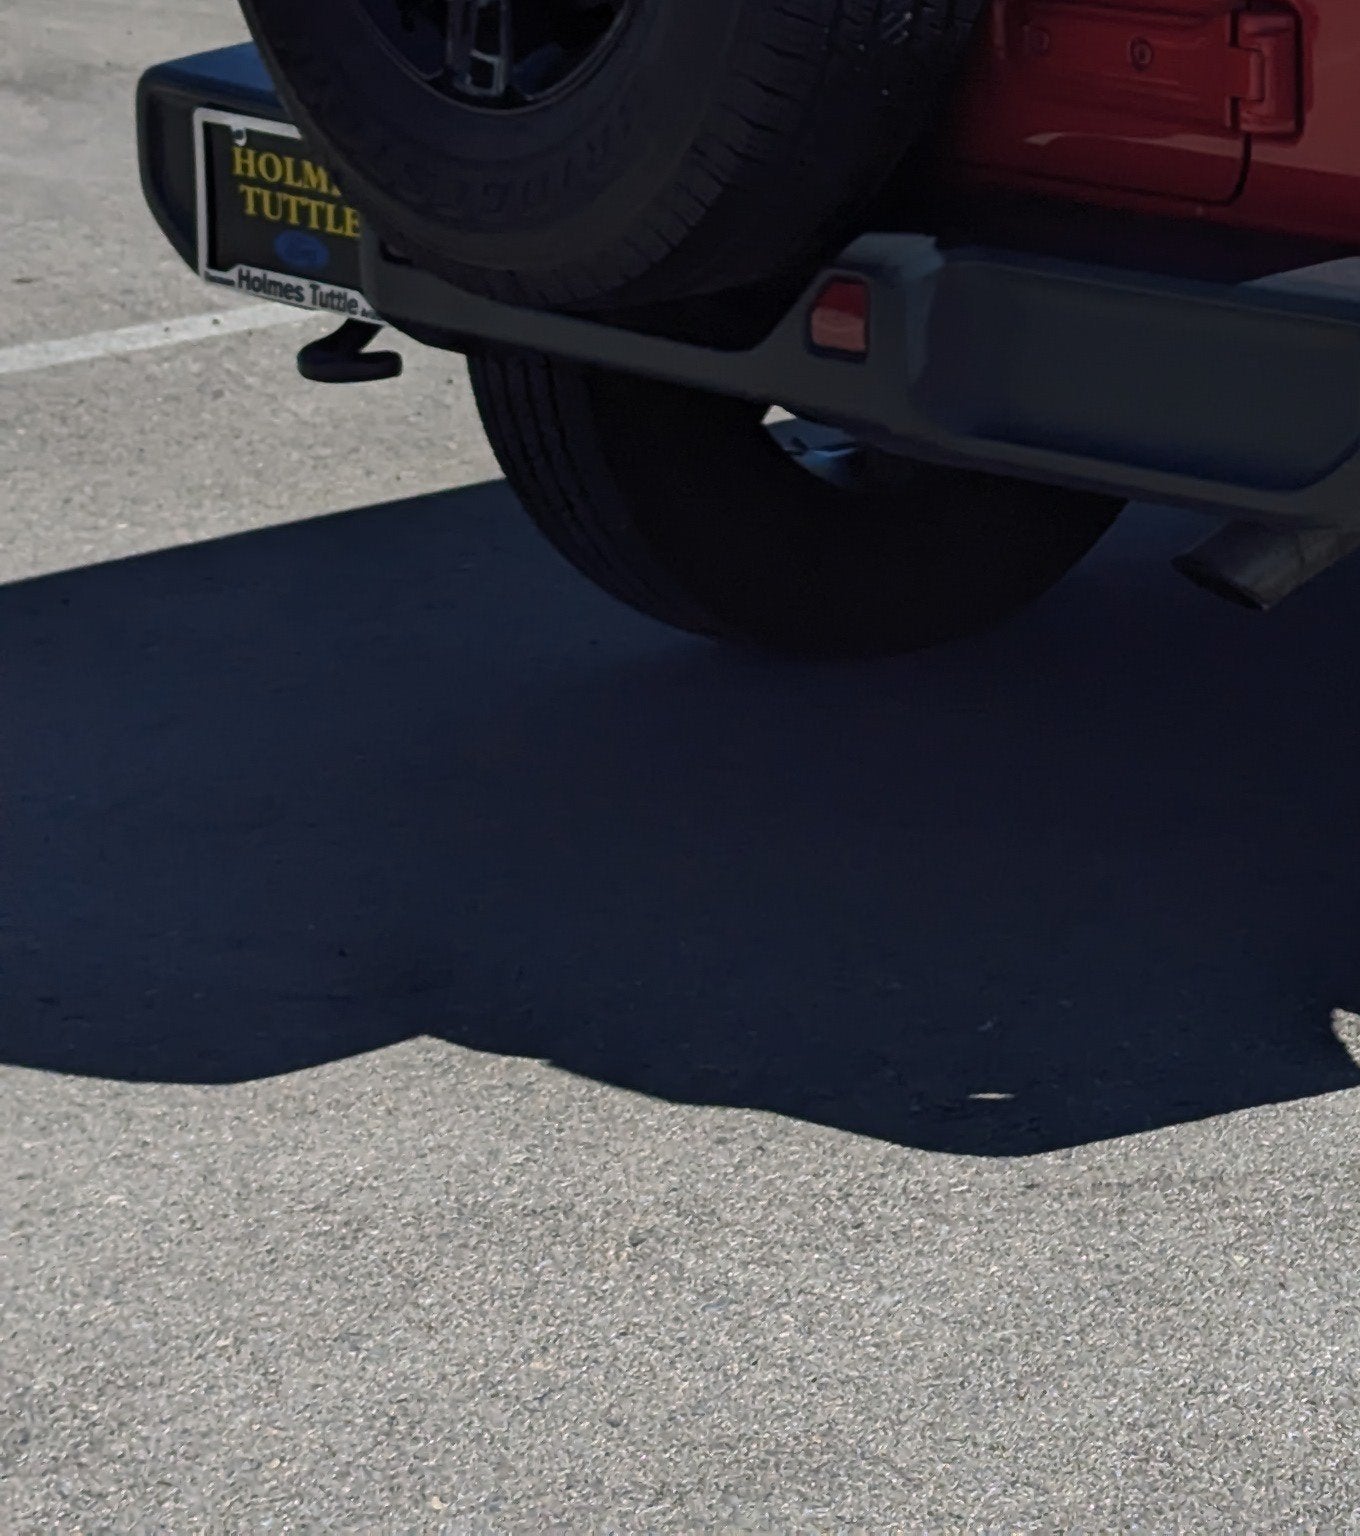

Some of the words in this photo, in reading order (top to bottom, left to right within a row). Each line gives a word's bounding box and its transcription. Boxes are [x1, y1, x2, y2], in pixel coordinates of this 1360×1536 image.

[231, 146, 343, 197] HOLM
[239, 183, 360, 238] TUTTLE
[237, 268, 305, 302] Holmes
[309, 283, 359, 314] Tuttle
